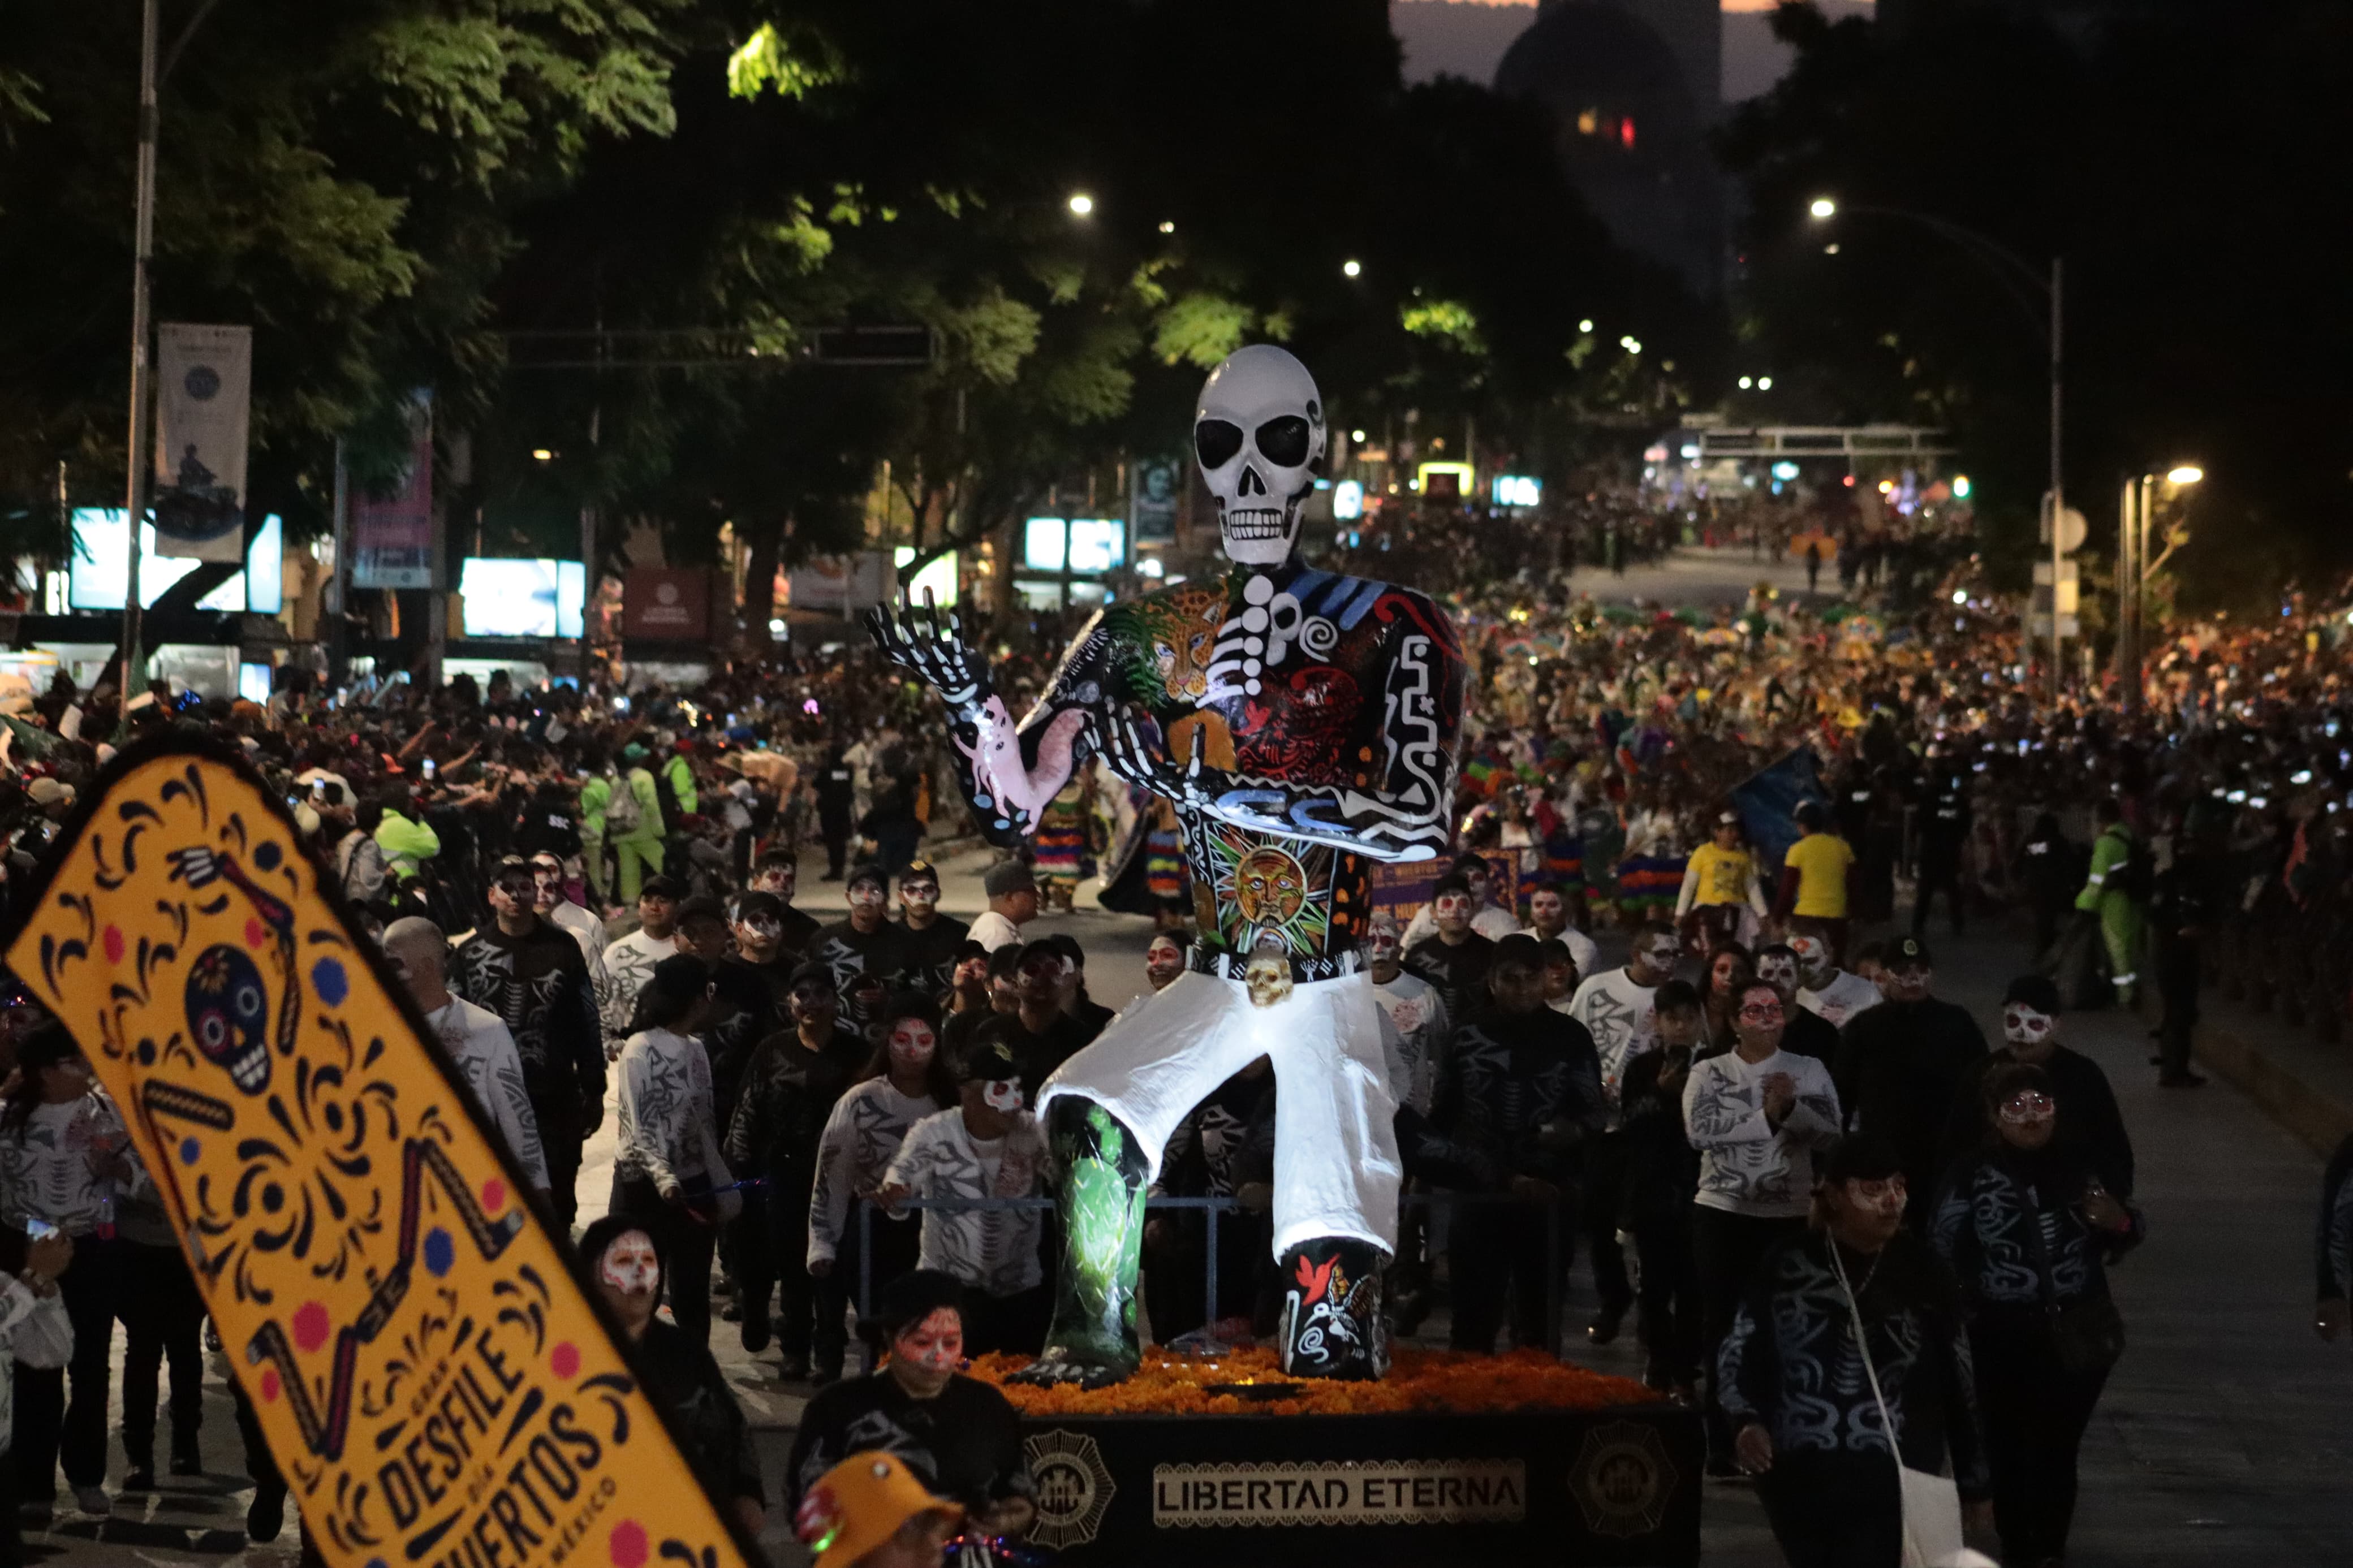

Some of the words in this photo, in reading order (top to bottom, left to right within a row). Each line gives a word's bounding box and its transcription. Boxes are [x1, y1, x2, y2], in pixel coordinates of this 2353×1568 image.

[378, 1328, 524, 1530] DESFILE
[432, 1402, 602, 1568] ERTOS
[1158, 1479, 1348, 1511] LIBERTAD
[1363, 1476, 1520, 1508] ETERNA
